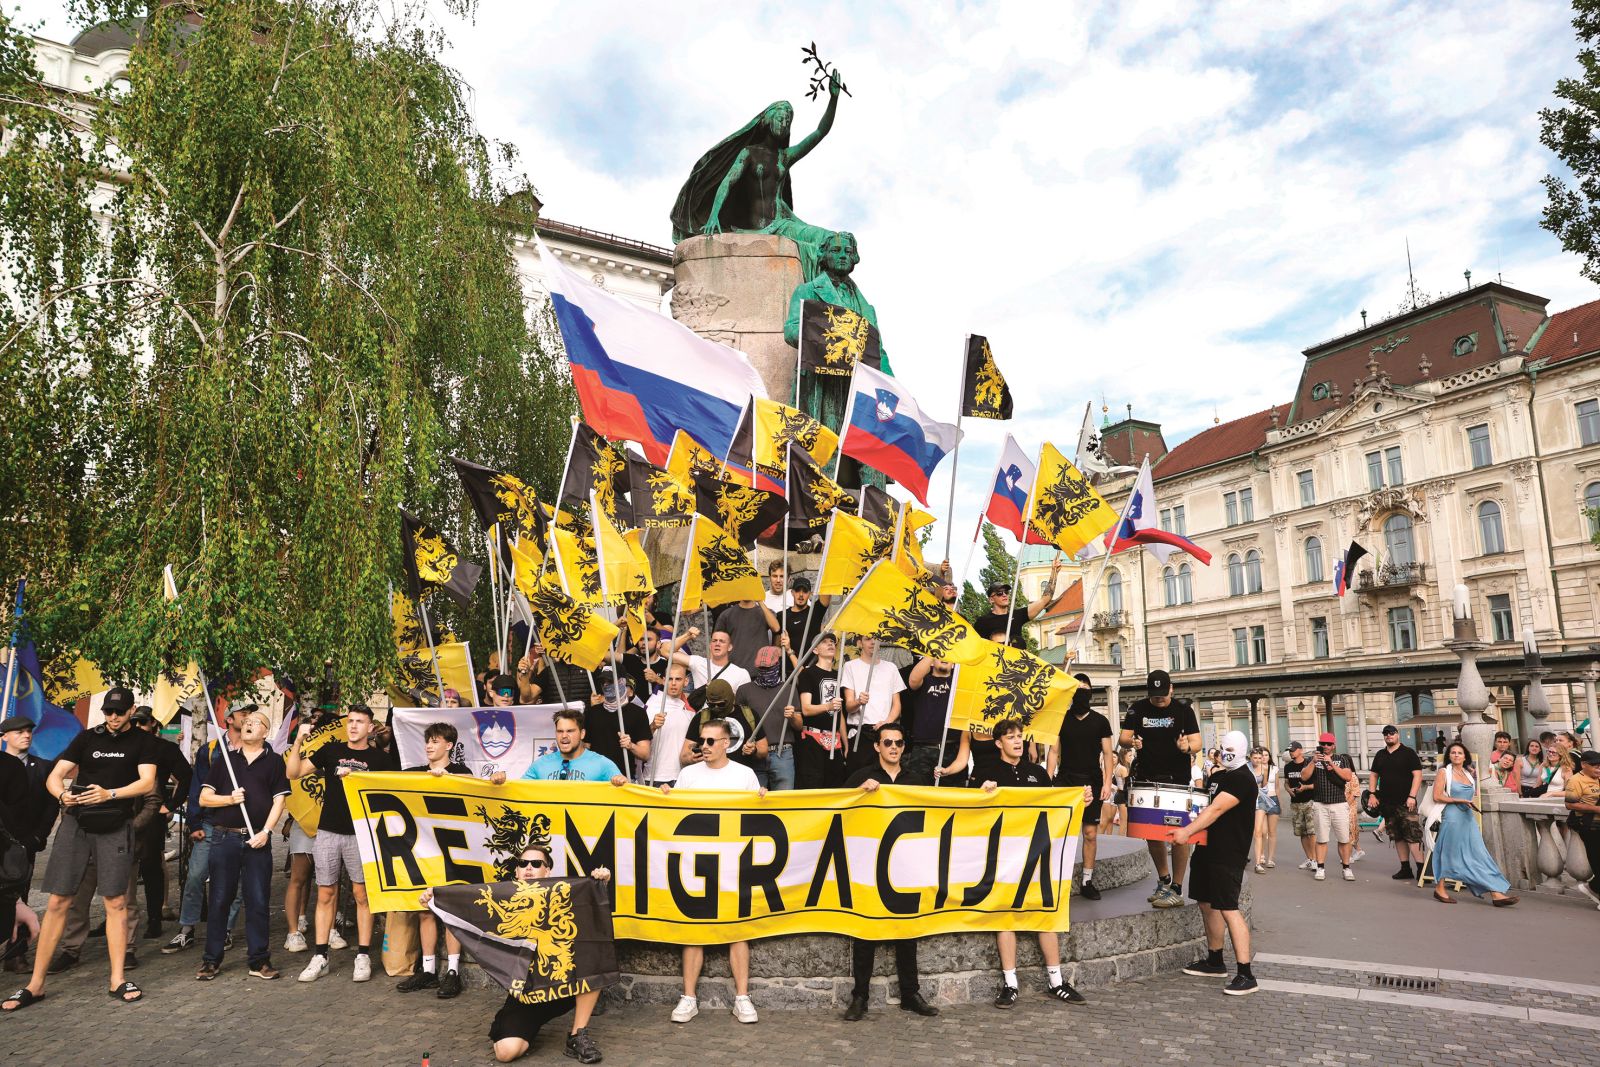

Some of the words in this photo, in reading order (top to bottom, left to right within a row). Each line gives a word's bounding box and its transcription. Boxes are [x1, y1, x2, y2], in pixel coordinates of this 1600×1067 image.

[814, 366, 855, 377] REMIGRA
[645, 518, 693, 529] REMIGRAC
[547, 769, 586, 780] CHMPS
